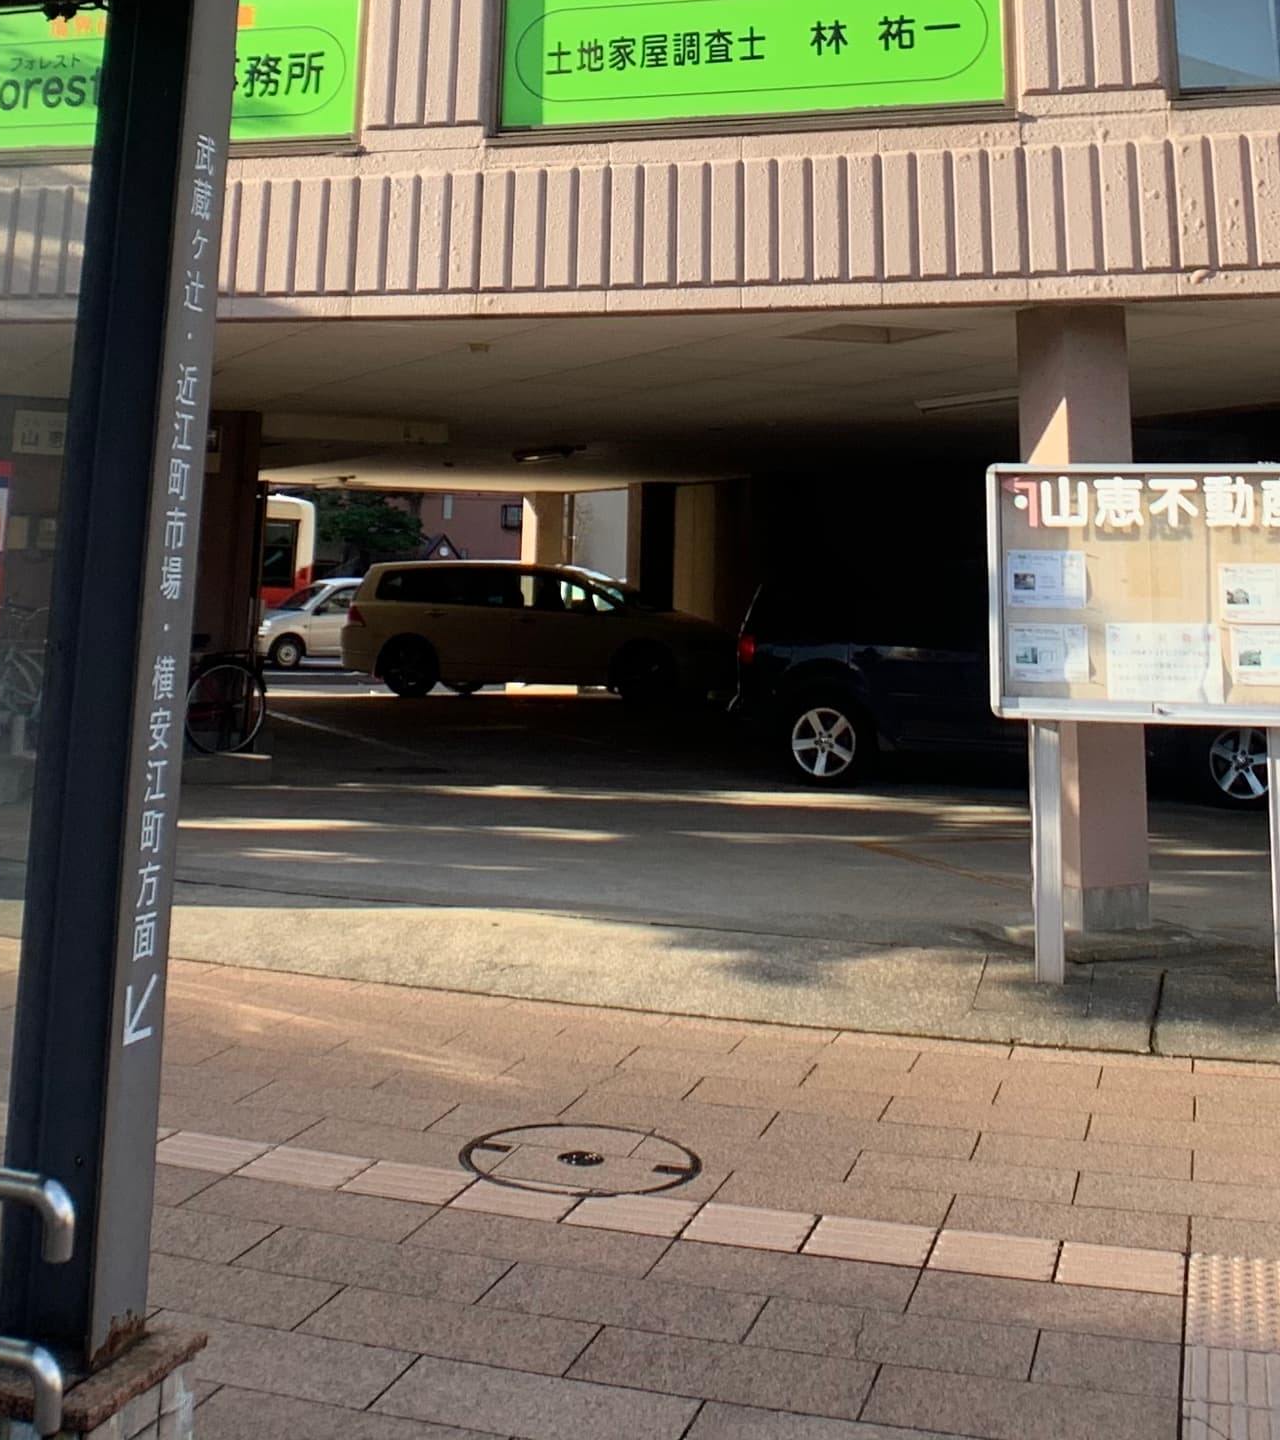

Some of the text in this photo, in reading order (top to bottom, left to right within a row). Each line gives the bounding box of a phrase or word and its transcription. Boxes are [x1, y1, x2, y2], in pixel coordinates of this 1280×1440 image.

[544, 13, 962, 77] 土地家屋調査士 林 祐一
[234, 50, 325, 98] 務所
